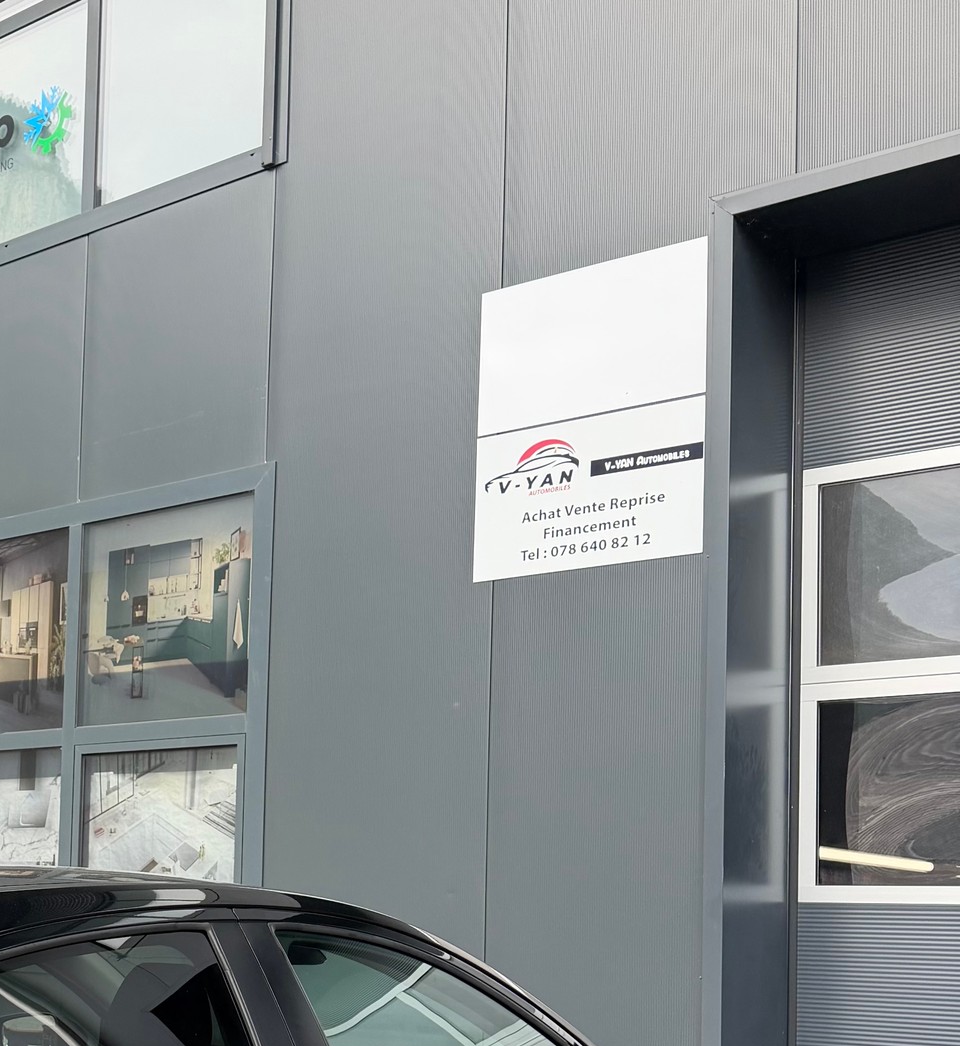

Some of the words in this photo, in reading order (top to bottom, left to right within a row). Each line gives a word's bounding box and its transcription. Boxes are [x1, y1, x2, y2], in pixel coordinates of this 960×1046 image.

[604, 459, 635, 471] V-YAN
[498, 469, 574, 494] V-YAN
[528, 484, 571, 496] AUTOMOBILES
[521, 507, 561, 524] Achat
[564, 501, 606, 517] Vente
[610, 492, 666, 510] Reprise
[543, 515, 637, 539] Financement
[551, 543, 577, 558] 078
[580, 539, 607, 553] 640
[611, 536, 629, 549] 82
[634, 533, 651, 546] 12
